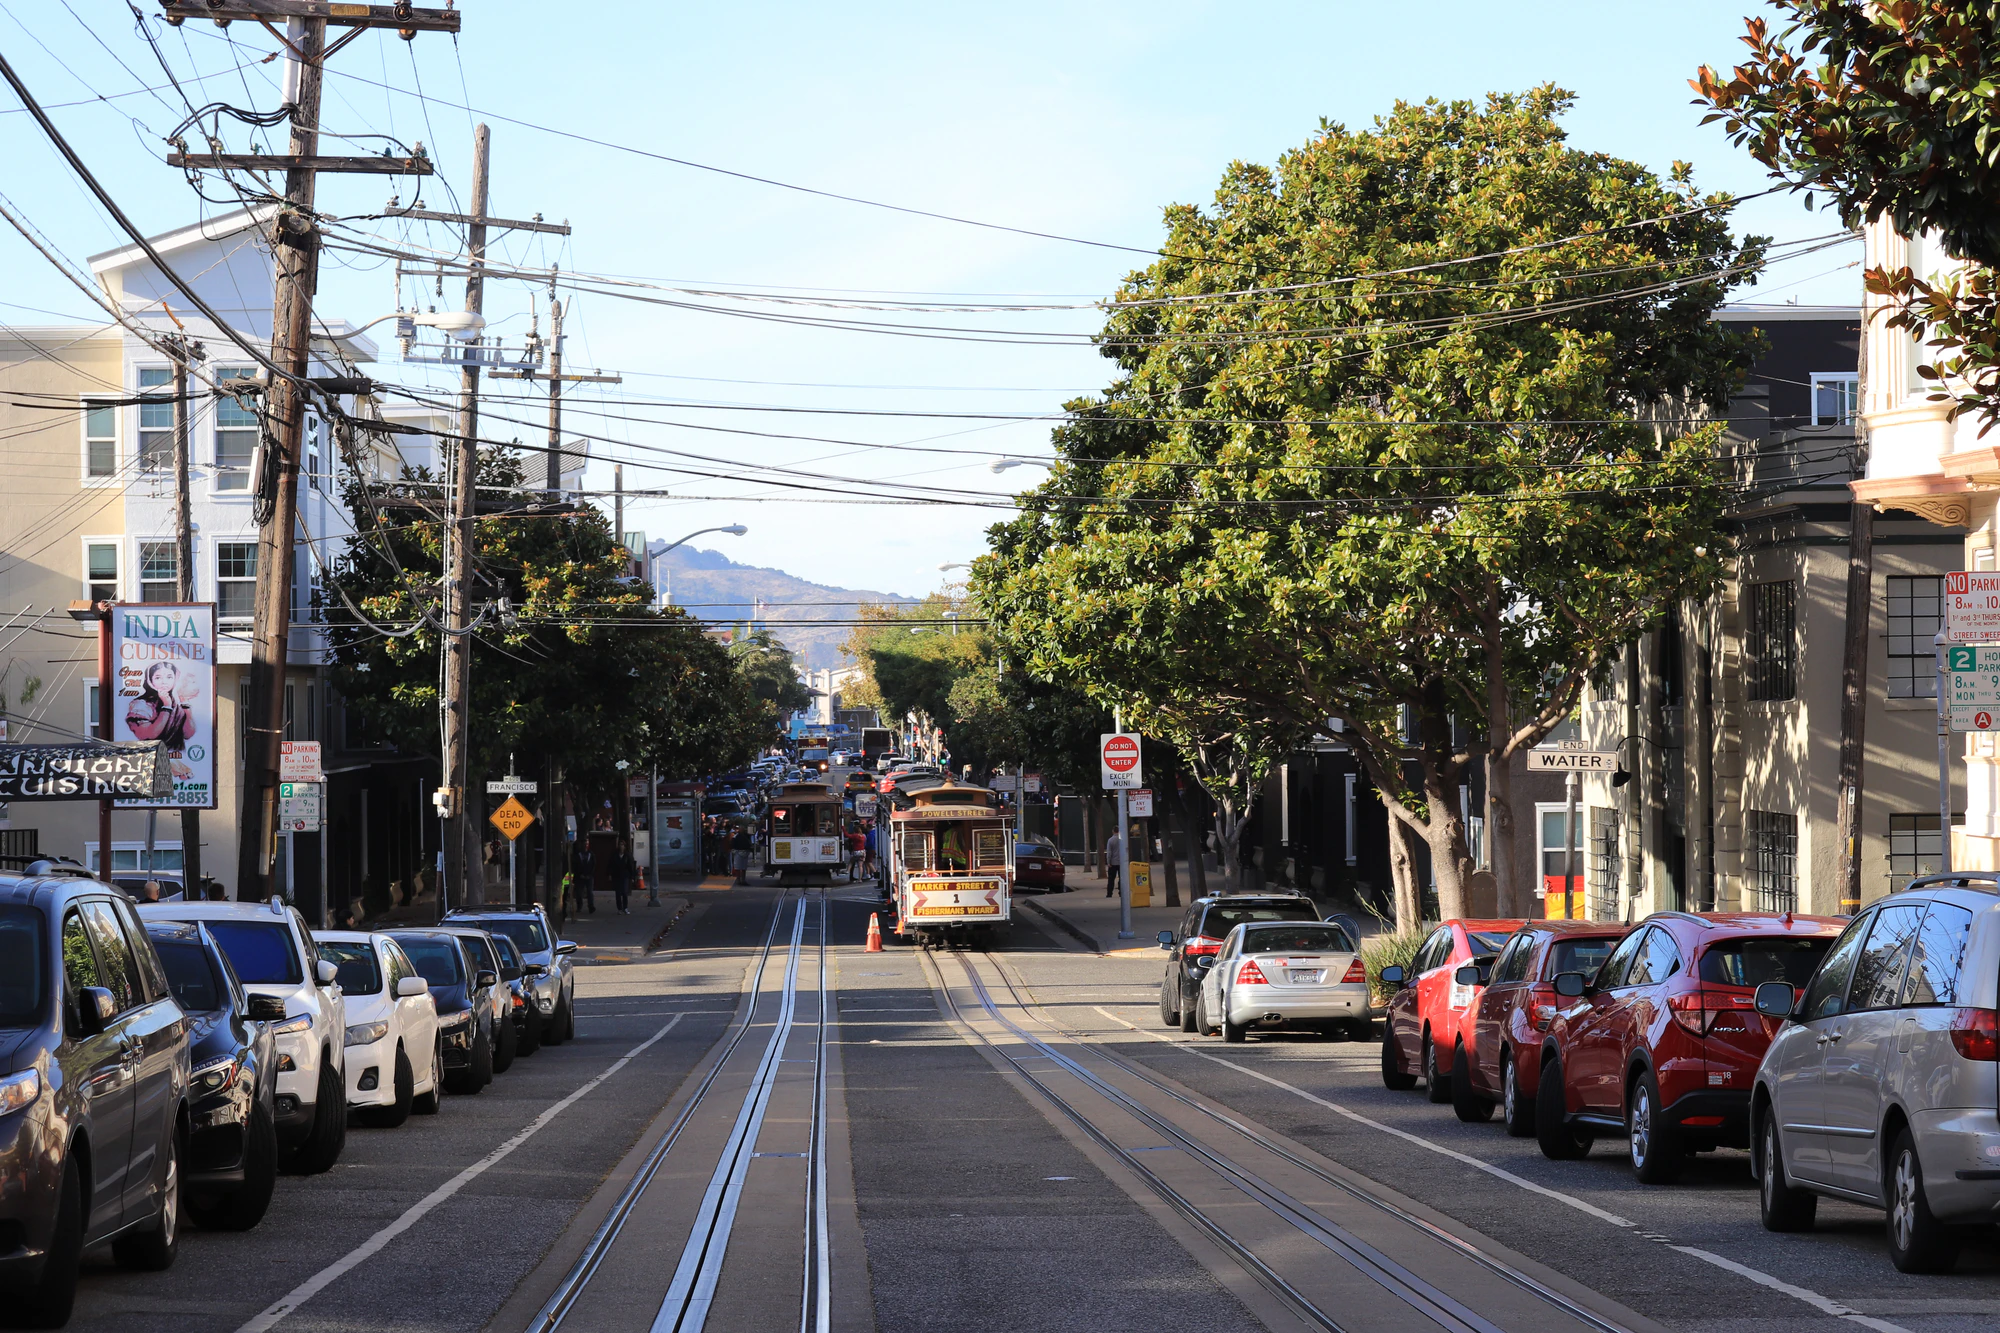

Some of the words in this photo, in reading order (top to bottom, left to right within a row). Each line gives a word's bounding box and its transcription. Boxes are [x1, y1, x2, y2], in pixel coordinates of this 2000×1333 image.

[1949, 574, 1966, 592] NO
[1986, 595, 2000, 609] 10
[1953, 631, 1978, 639] STREET
[1956, 650, 1970, 669] 2
[118, 665, 143, 680] Open
[1991, 675, 1999, 688] 9
[1955, 691, 1975, 701] MON
[1976, 712, 1990, 726] A
[281, 743, 292, 754] NO
[294, 745, 317, 753] PARKING
[1563, 741, 1584, 749] END
[1541, 754, 1602, 767] WATER
[1109, 772, 1134, 780] EXCEPT
[283, 785, 291, 796] 2
[489, 783, 535, 791] FRANCISCO
[499, 810, 524, 818] DEAD
[503, 821, 521, 829] END
[914, 883, 950, 891] MARKET
[956, 882, 985, 890] STREET
[953, 893, 960, 904] 1
[916, 907, 965, 915] FISHERMANS
[967, 906, 995, 914] WHARF
[1722, 1071, 1732, 1079] 18
